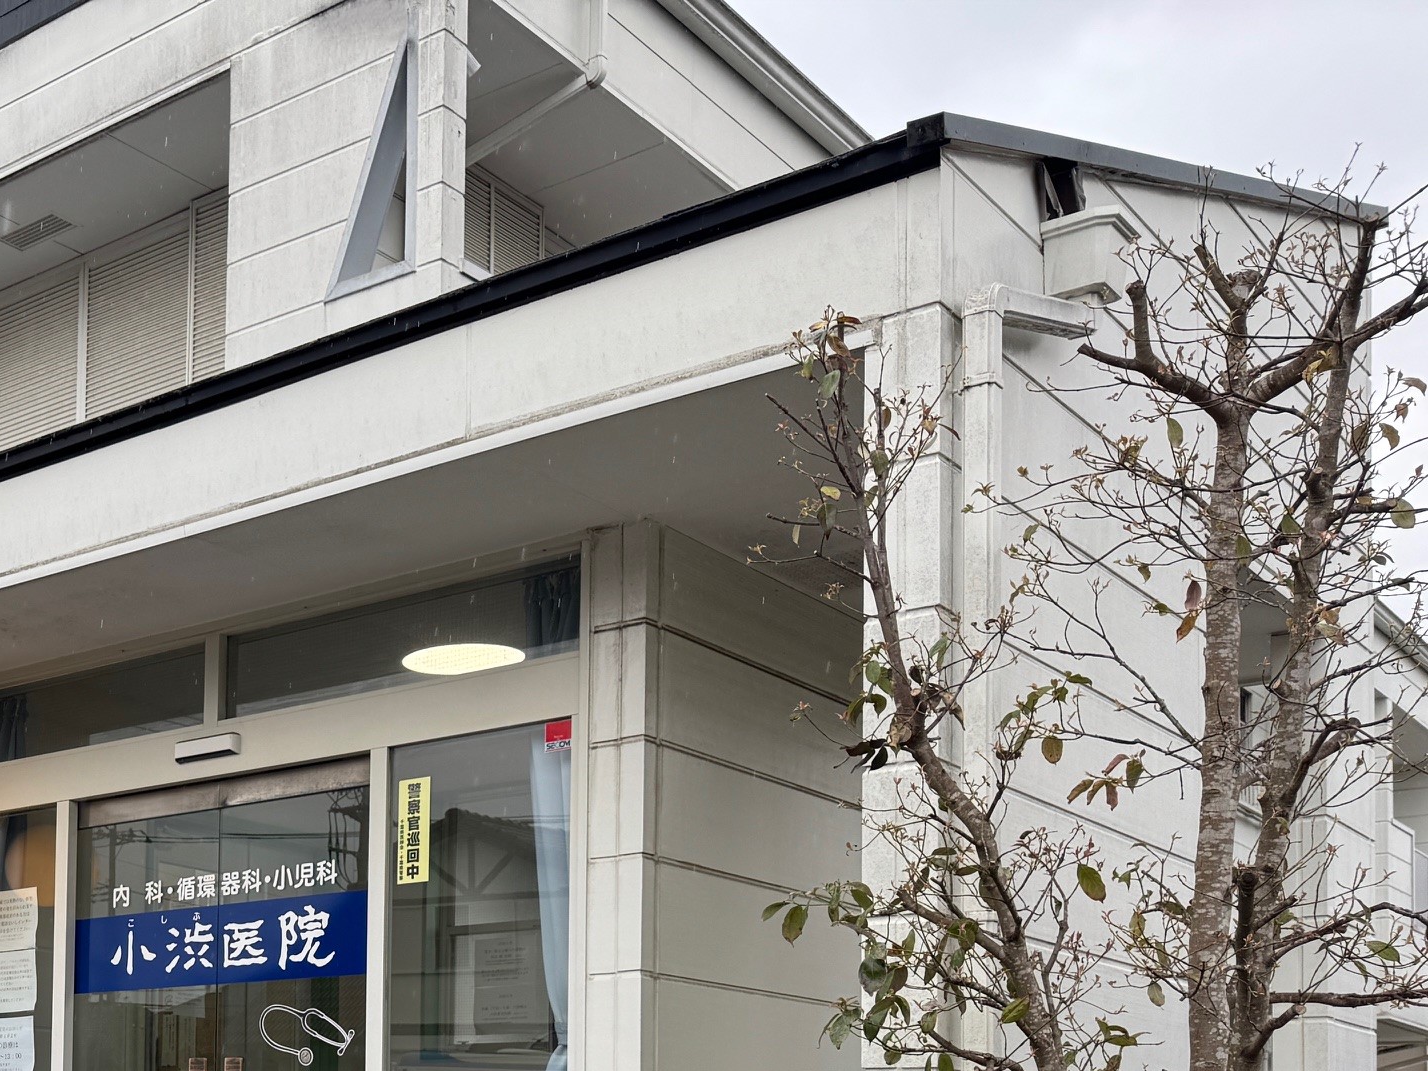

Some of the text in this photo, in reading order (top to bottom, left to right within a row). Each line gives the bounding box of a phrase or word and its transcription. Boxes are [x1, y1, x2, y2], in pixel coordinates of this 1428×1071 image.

[406, 782, 421, 880] 警察官巡回中
[110, 905, 335, 975] 小渋医院
